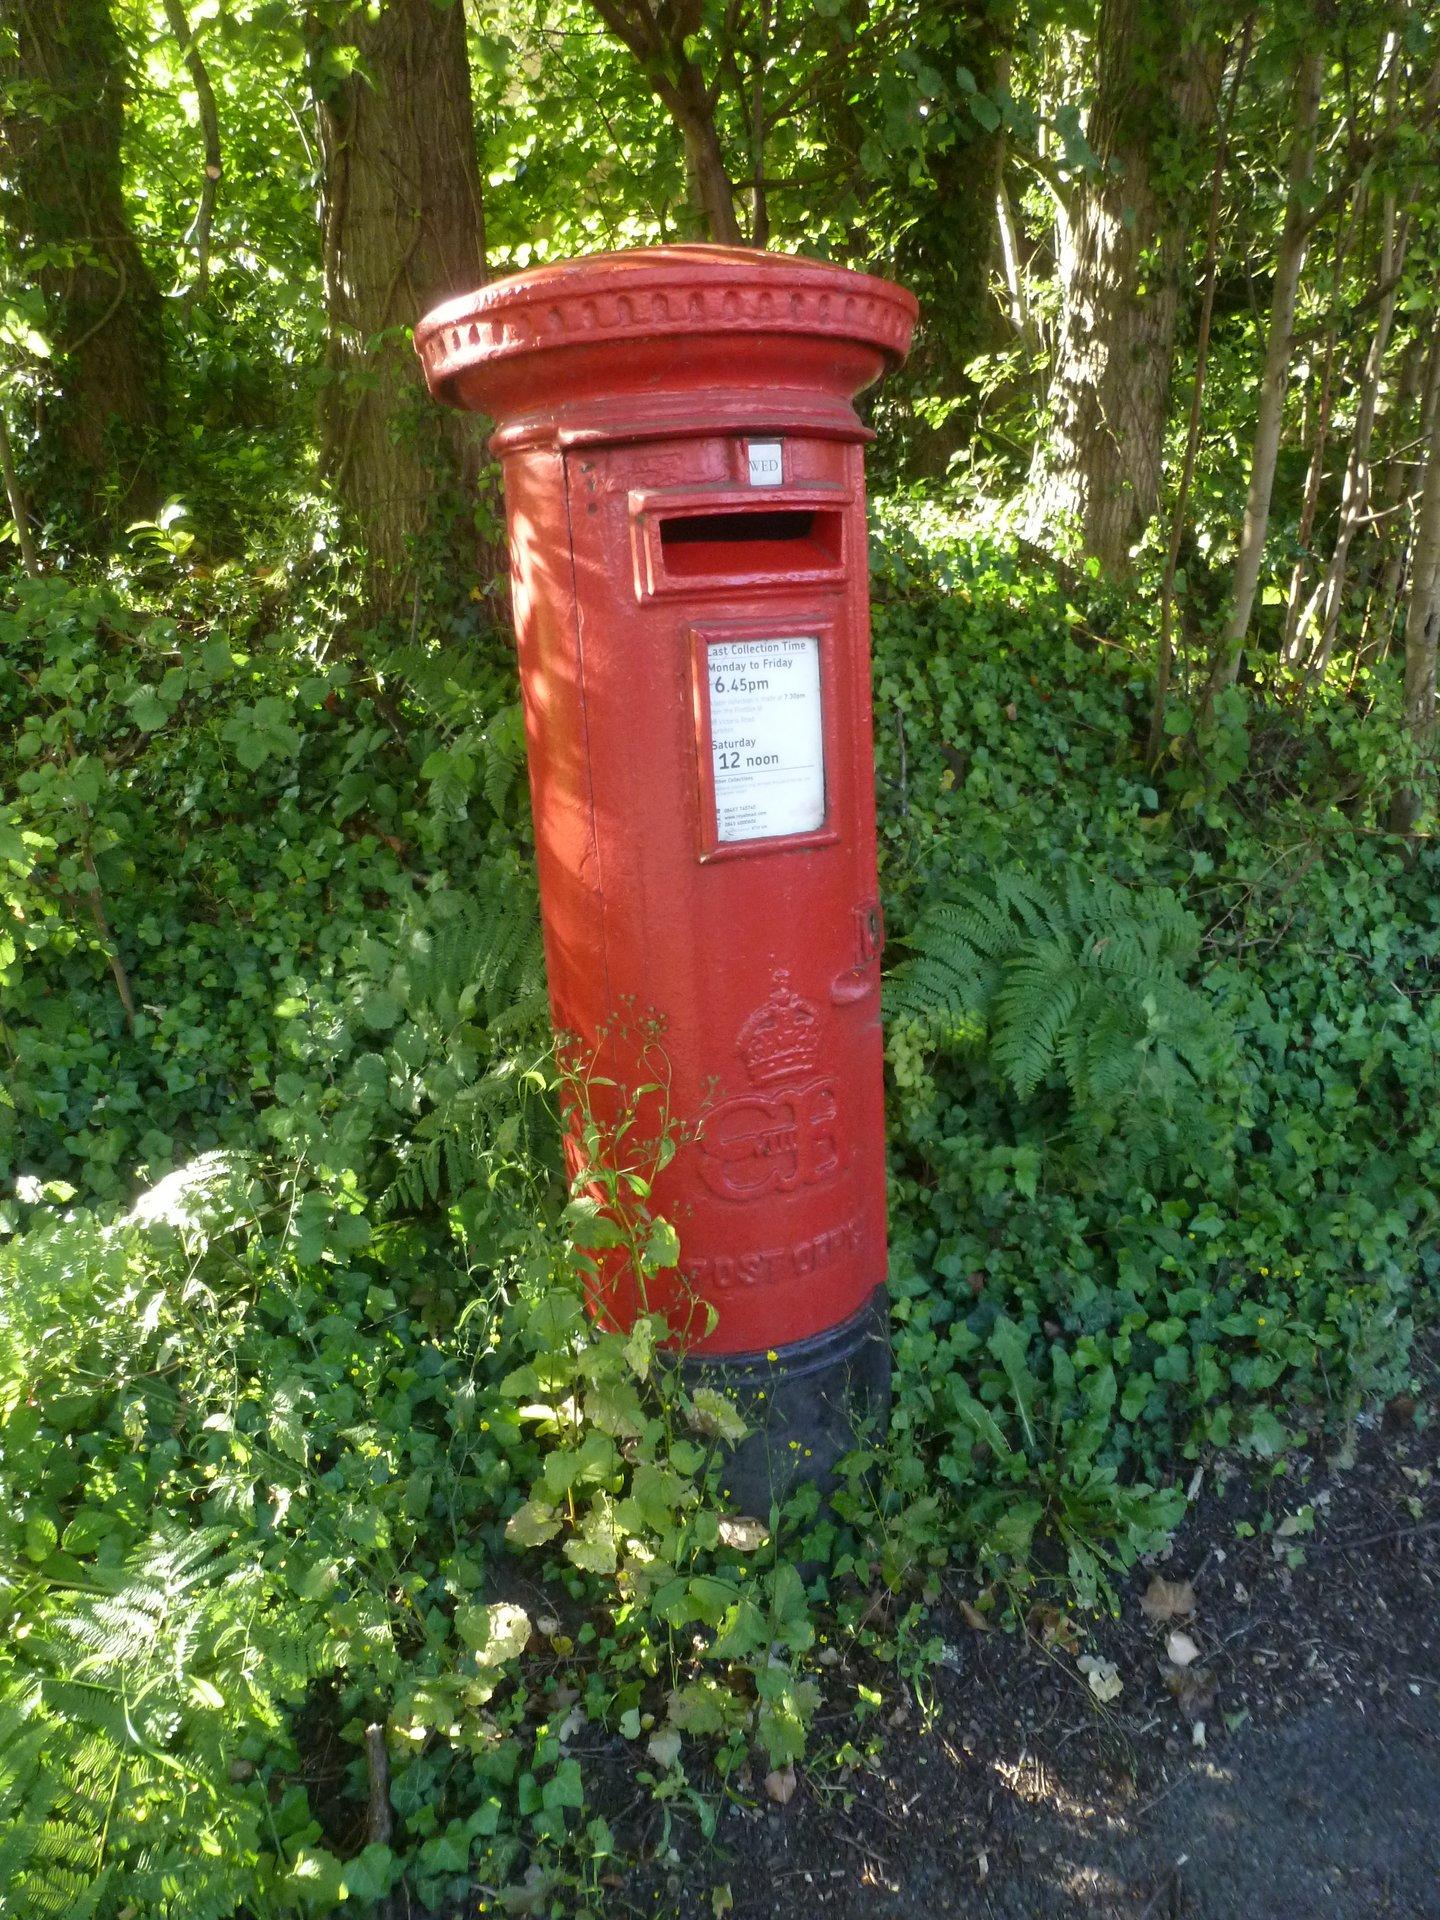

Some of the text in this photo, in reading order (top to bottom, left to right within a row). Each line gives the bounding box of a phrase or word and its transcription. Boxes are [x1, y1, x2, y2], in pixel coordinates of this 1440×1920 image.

[749, 460, 779, 472] WED
[708, 641, 806, 656] Last Collection Time
[708, 658, 793, 673] Monday to Friday
[715, 676, 769, 694] 6.45pm
[712, 738, 756, 750] Saturday
[719, 752, 779, 770] 12 noon
